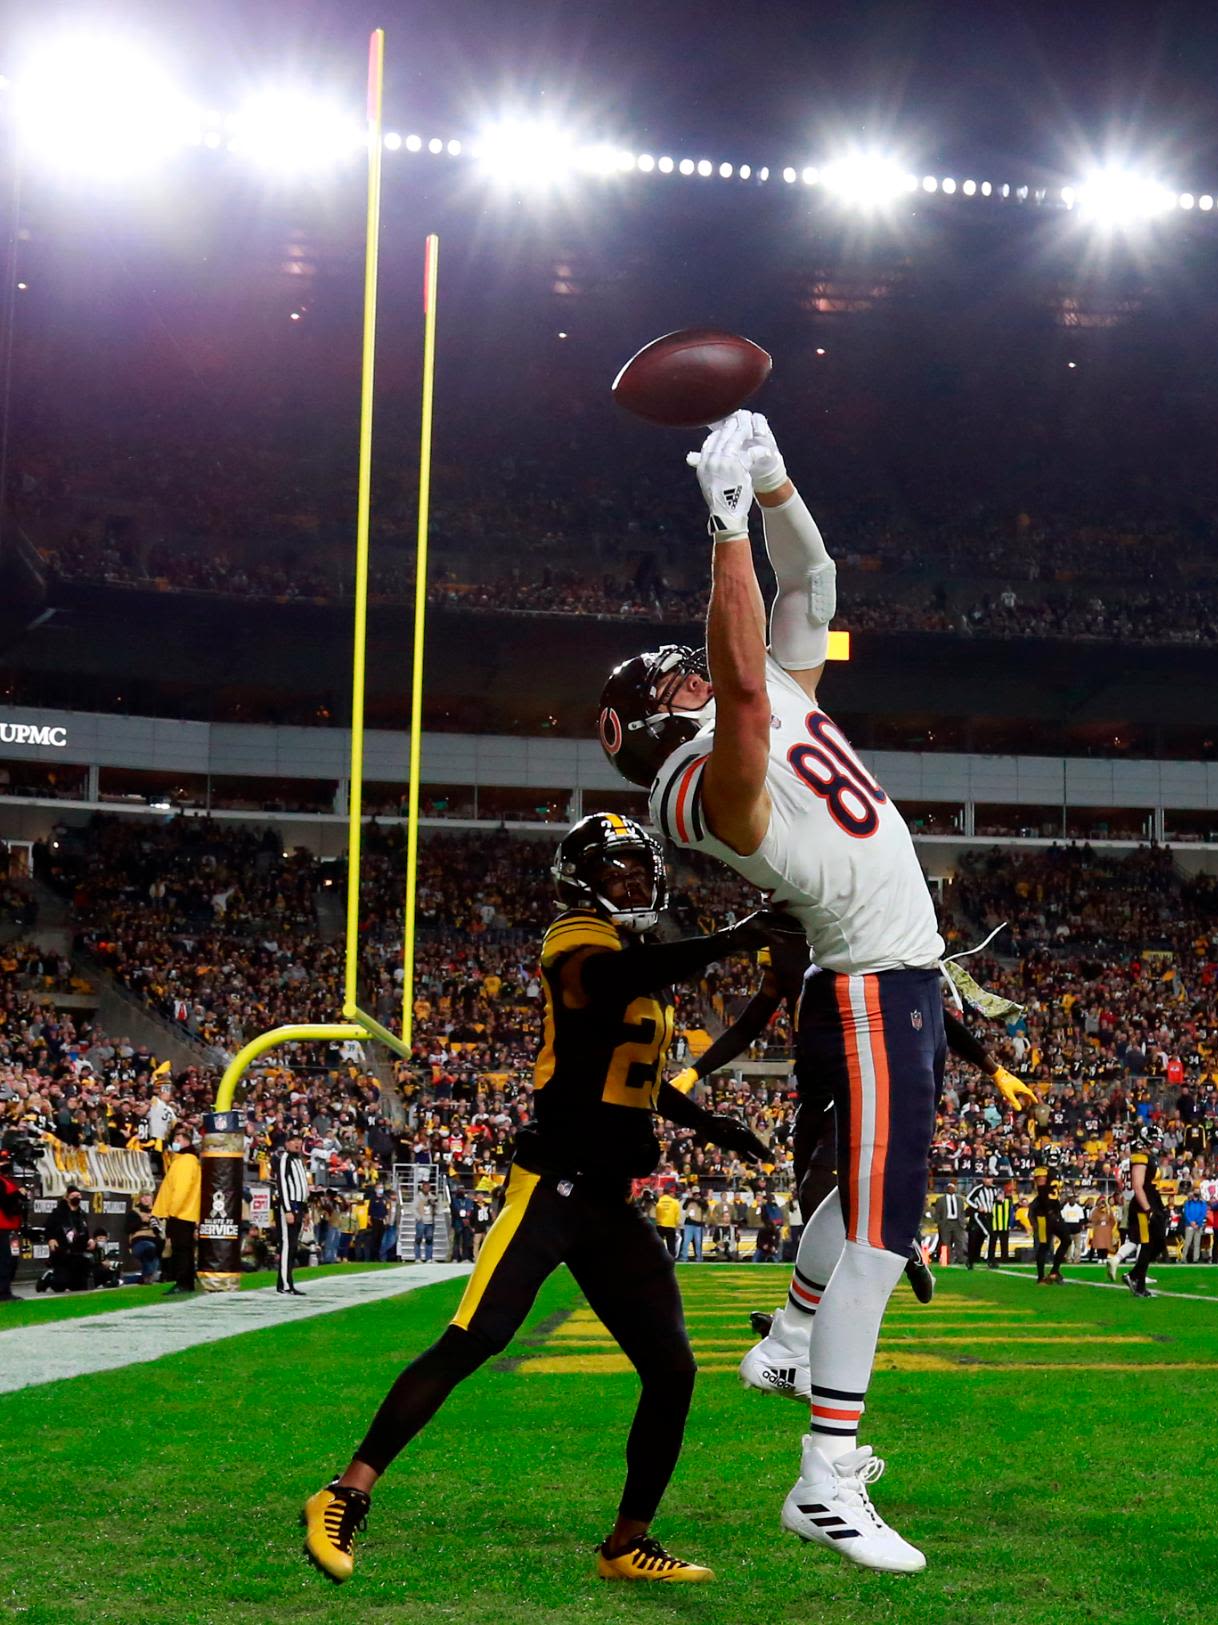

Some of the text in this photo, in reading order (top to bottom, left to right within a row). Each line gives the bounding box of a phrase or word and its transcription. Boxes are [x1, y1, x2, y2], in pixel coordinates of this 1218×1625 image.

[0, 723, 67, 747] UPMC
[786, 710, 886, 839] 80
[199, 1224, 239, 1236] SERVICE
